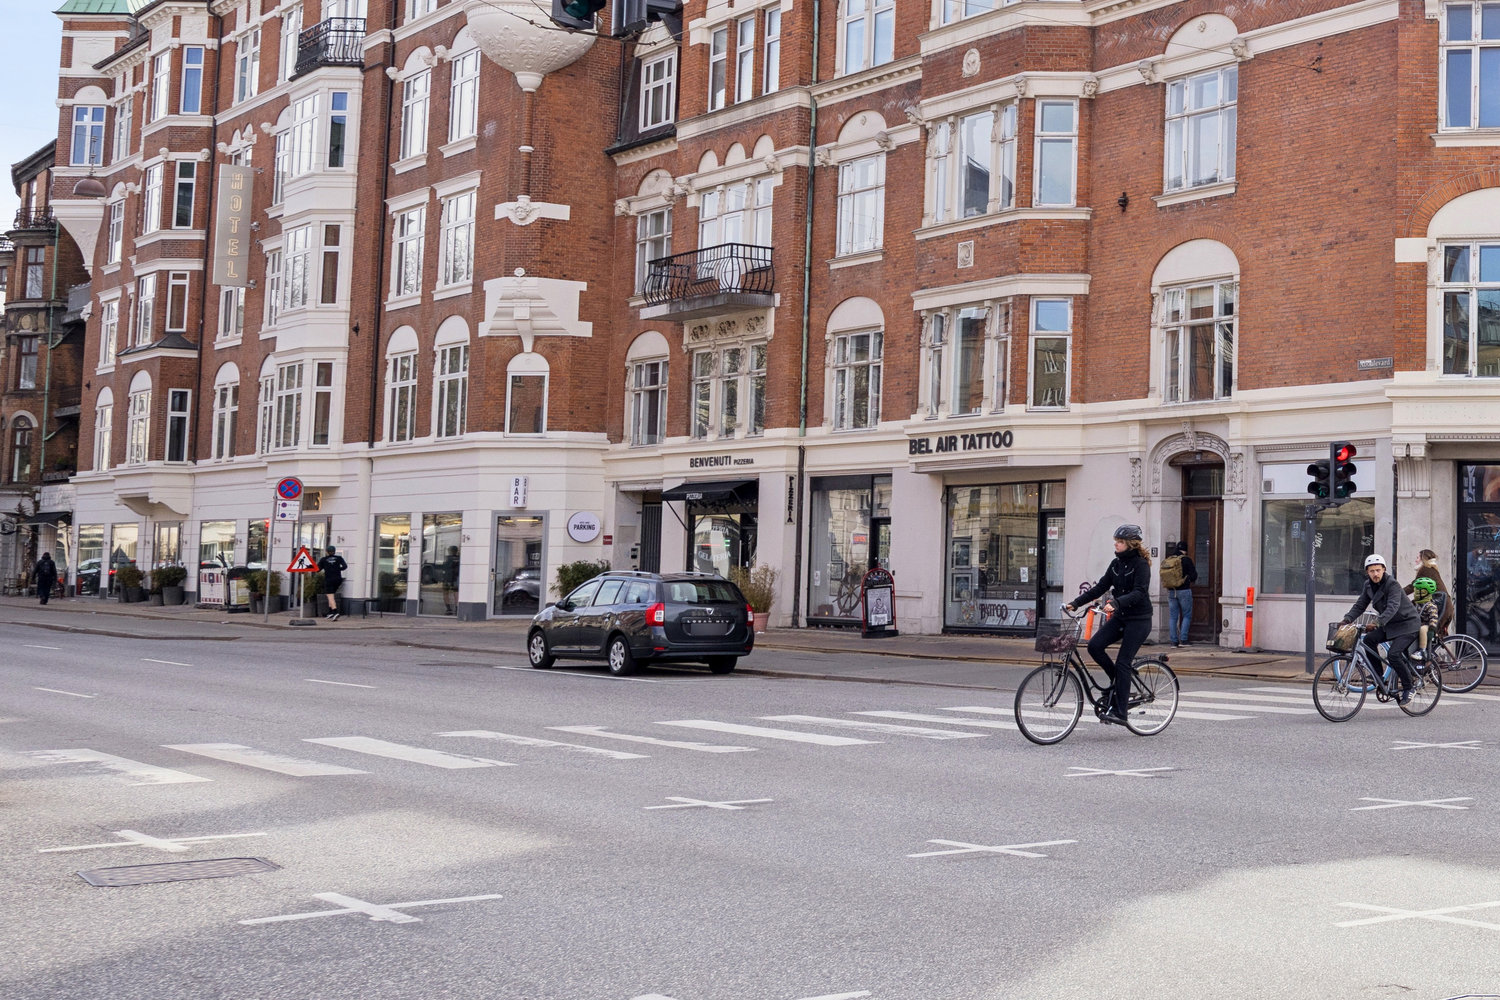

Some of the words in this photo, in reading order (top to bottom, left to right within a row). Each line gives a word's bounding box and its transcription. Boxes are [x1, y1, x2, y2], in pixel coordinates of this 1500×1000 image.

[227, 172, 243, 279] HOTEL
[909, 438, 933, 455] BEL
[935, 435, 957, 452] AIR
[960, 430, 1014, 450] TATTOO
[689, 455, 732, 468] BENVENUTI
[733, 458, 754, 466] PIZZERIA
[786, 476, 794, 523] PIZZERIA
